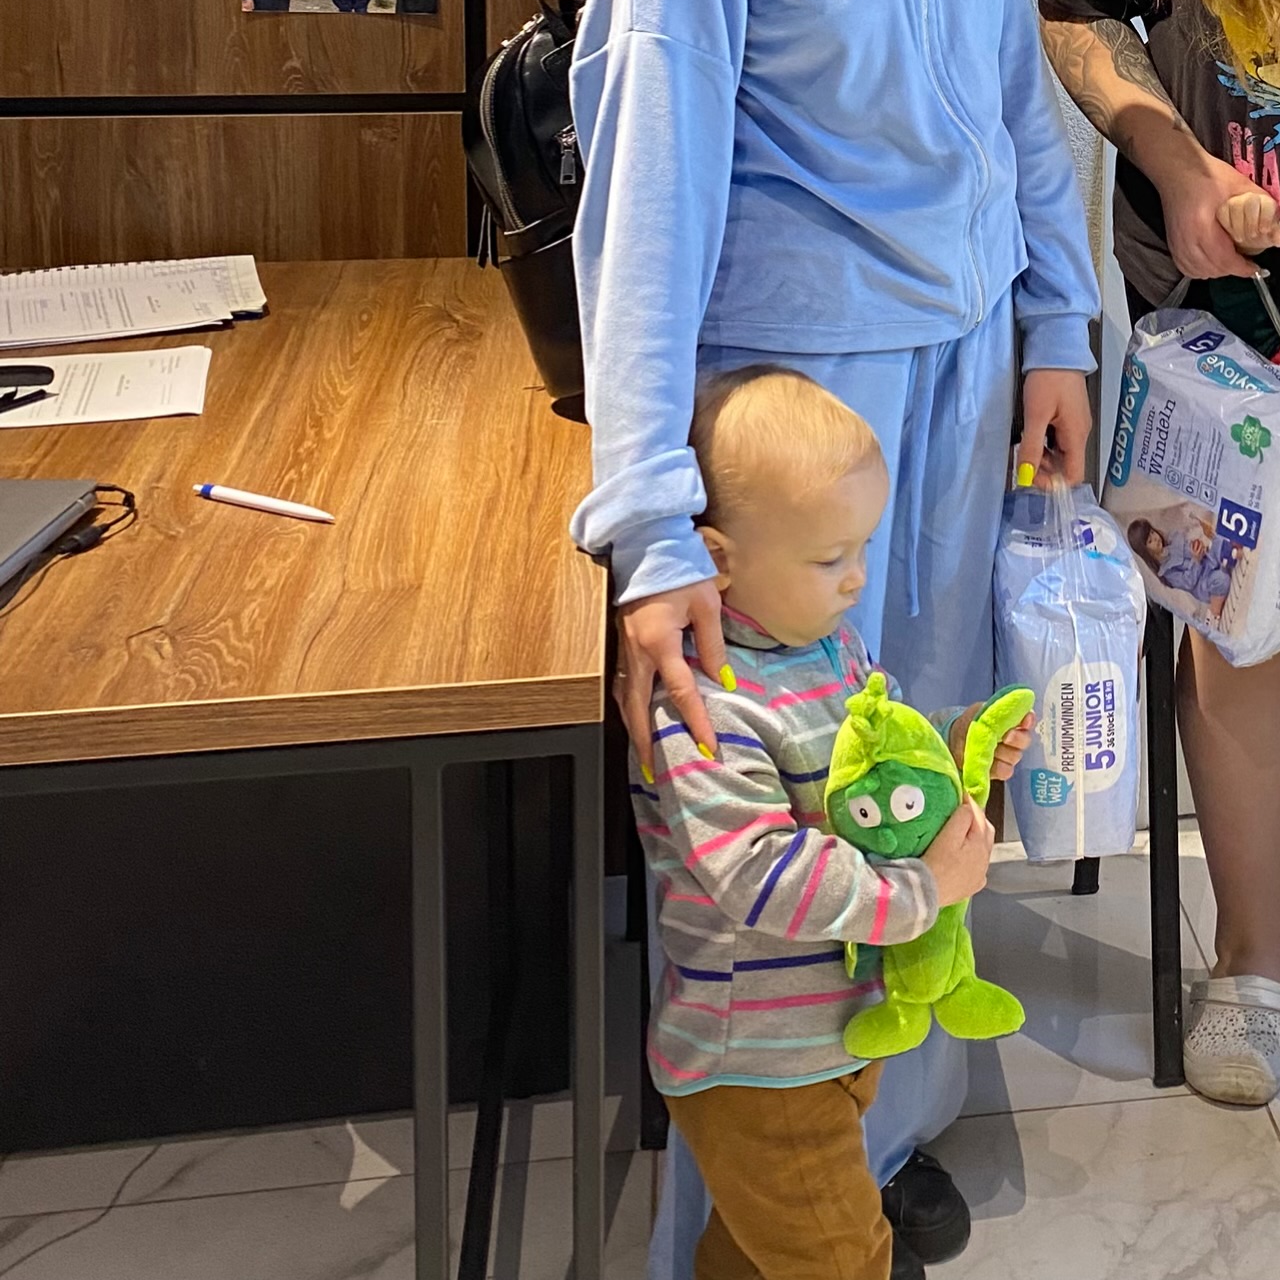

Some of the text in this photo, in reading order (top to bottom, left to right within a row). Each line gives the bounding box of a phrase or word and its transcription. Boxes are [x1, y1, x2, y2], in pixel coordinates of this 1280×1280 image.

[1110, 365, 1143, 480] babylove
[1138, 405, 1156, 471] Premium-
[1149, 400, 1177, 476] Windeln
[1222, 508, 1248, 537] 5
[1061, 682, 1075, 772] PREMIUMWINDELN
[1085, 681, 1116, 770] 5 JUNIOR
[1107, 738, 1115, 748] 36
[1035, 773, 1047, 804] Hallo
[1049, 775, 1062, 803] Welt
